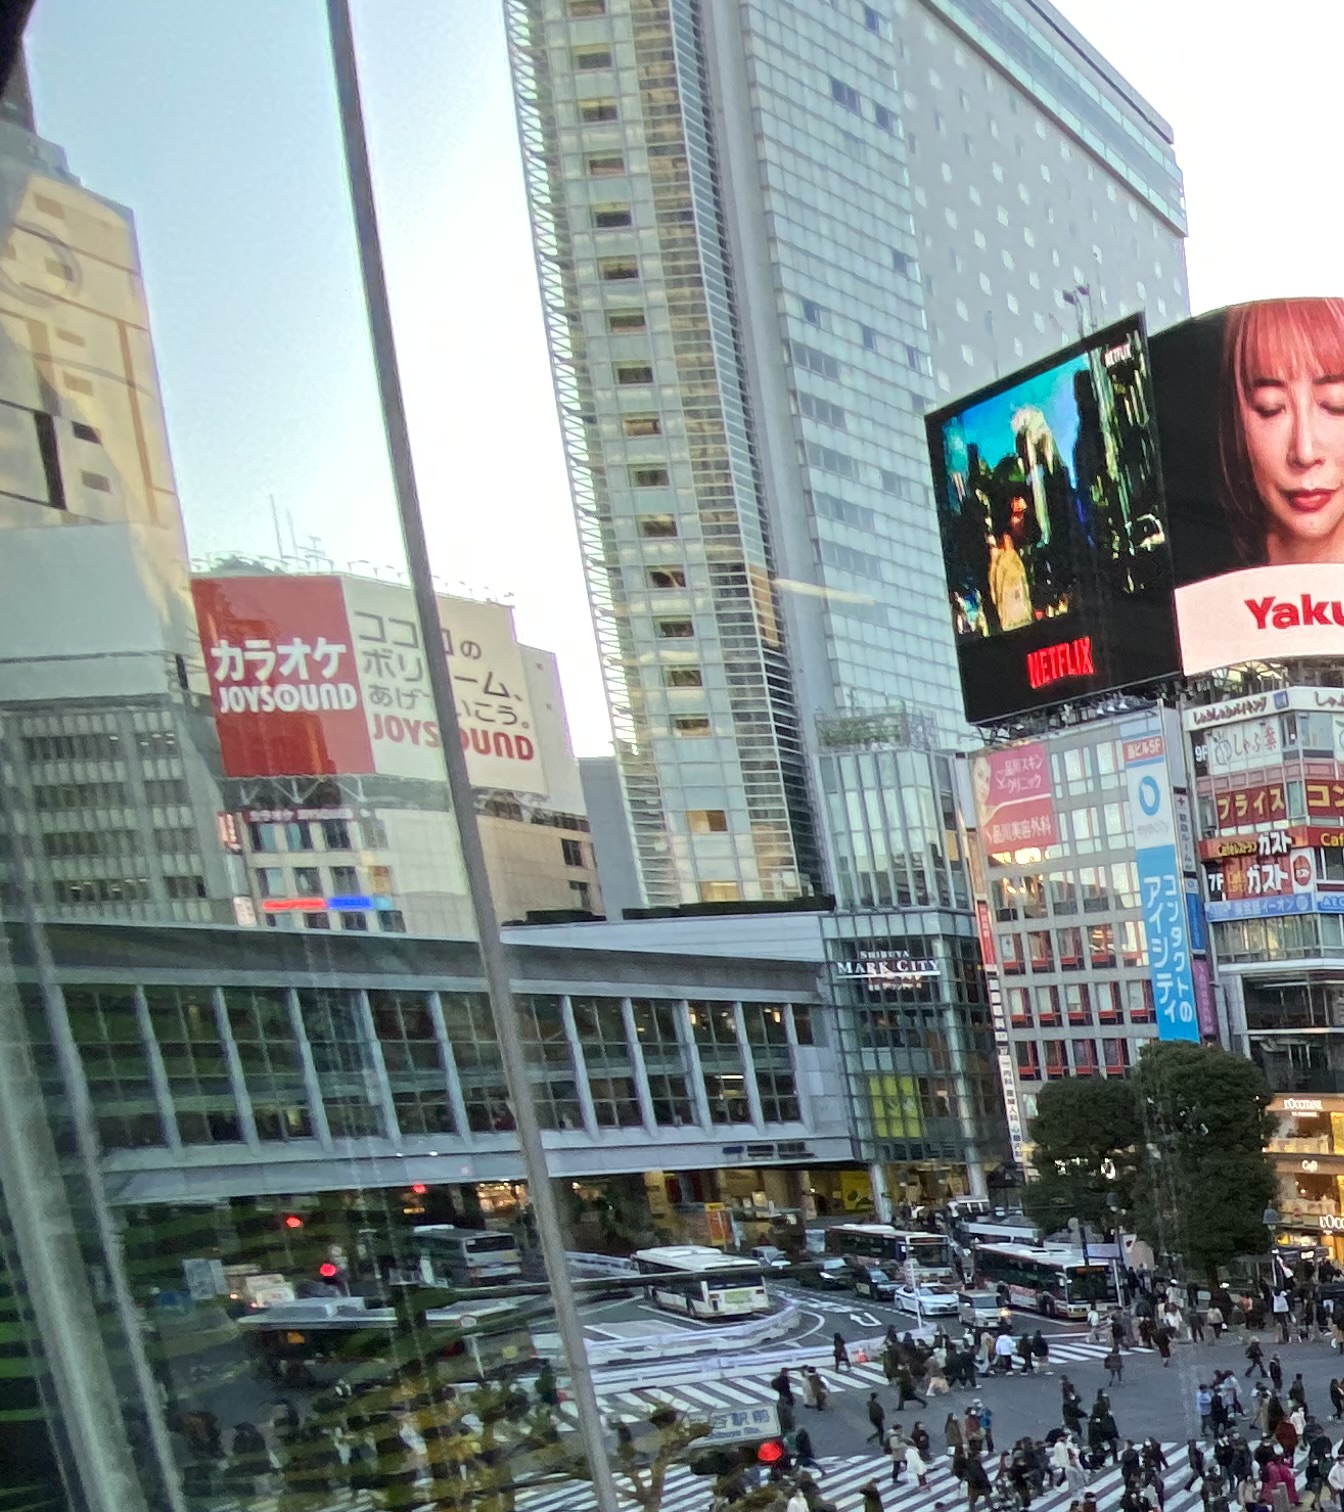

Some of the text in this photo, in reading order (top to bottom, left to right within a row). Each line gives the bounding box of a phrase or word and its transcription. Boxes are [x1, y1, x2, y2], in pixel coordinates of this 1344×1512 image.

[211, 637, 346, 682] カラオケ
[363, 647, 523, 703] ボリーム、
[1027, 637, 1094, 690] NETFLIX
[219, 683, 357, 714] JOYSOUND
[369, 685, 530, 729] あげいこう。
[1195, 745, 1208, 762] 9F
[1258, 830, 1292, 855] ガスト
[1208, 873, 1224, 892] 7F
[1247, 863, 1288, 894] ガスト
[859, 950, 910, 959] SHIBUYA
[1143, 876, 1176, 1024] アイシティ
[1163, 873, 1193, 1023] コンタクトの
[838, 959, 939, 975] MARK CITY
